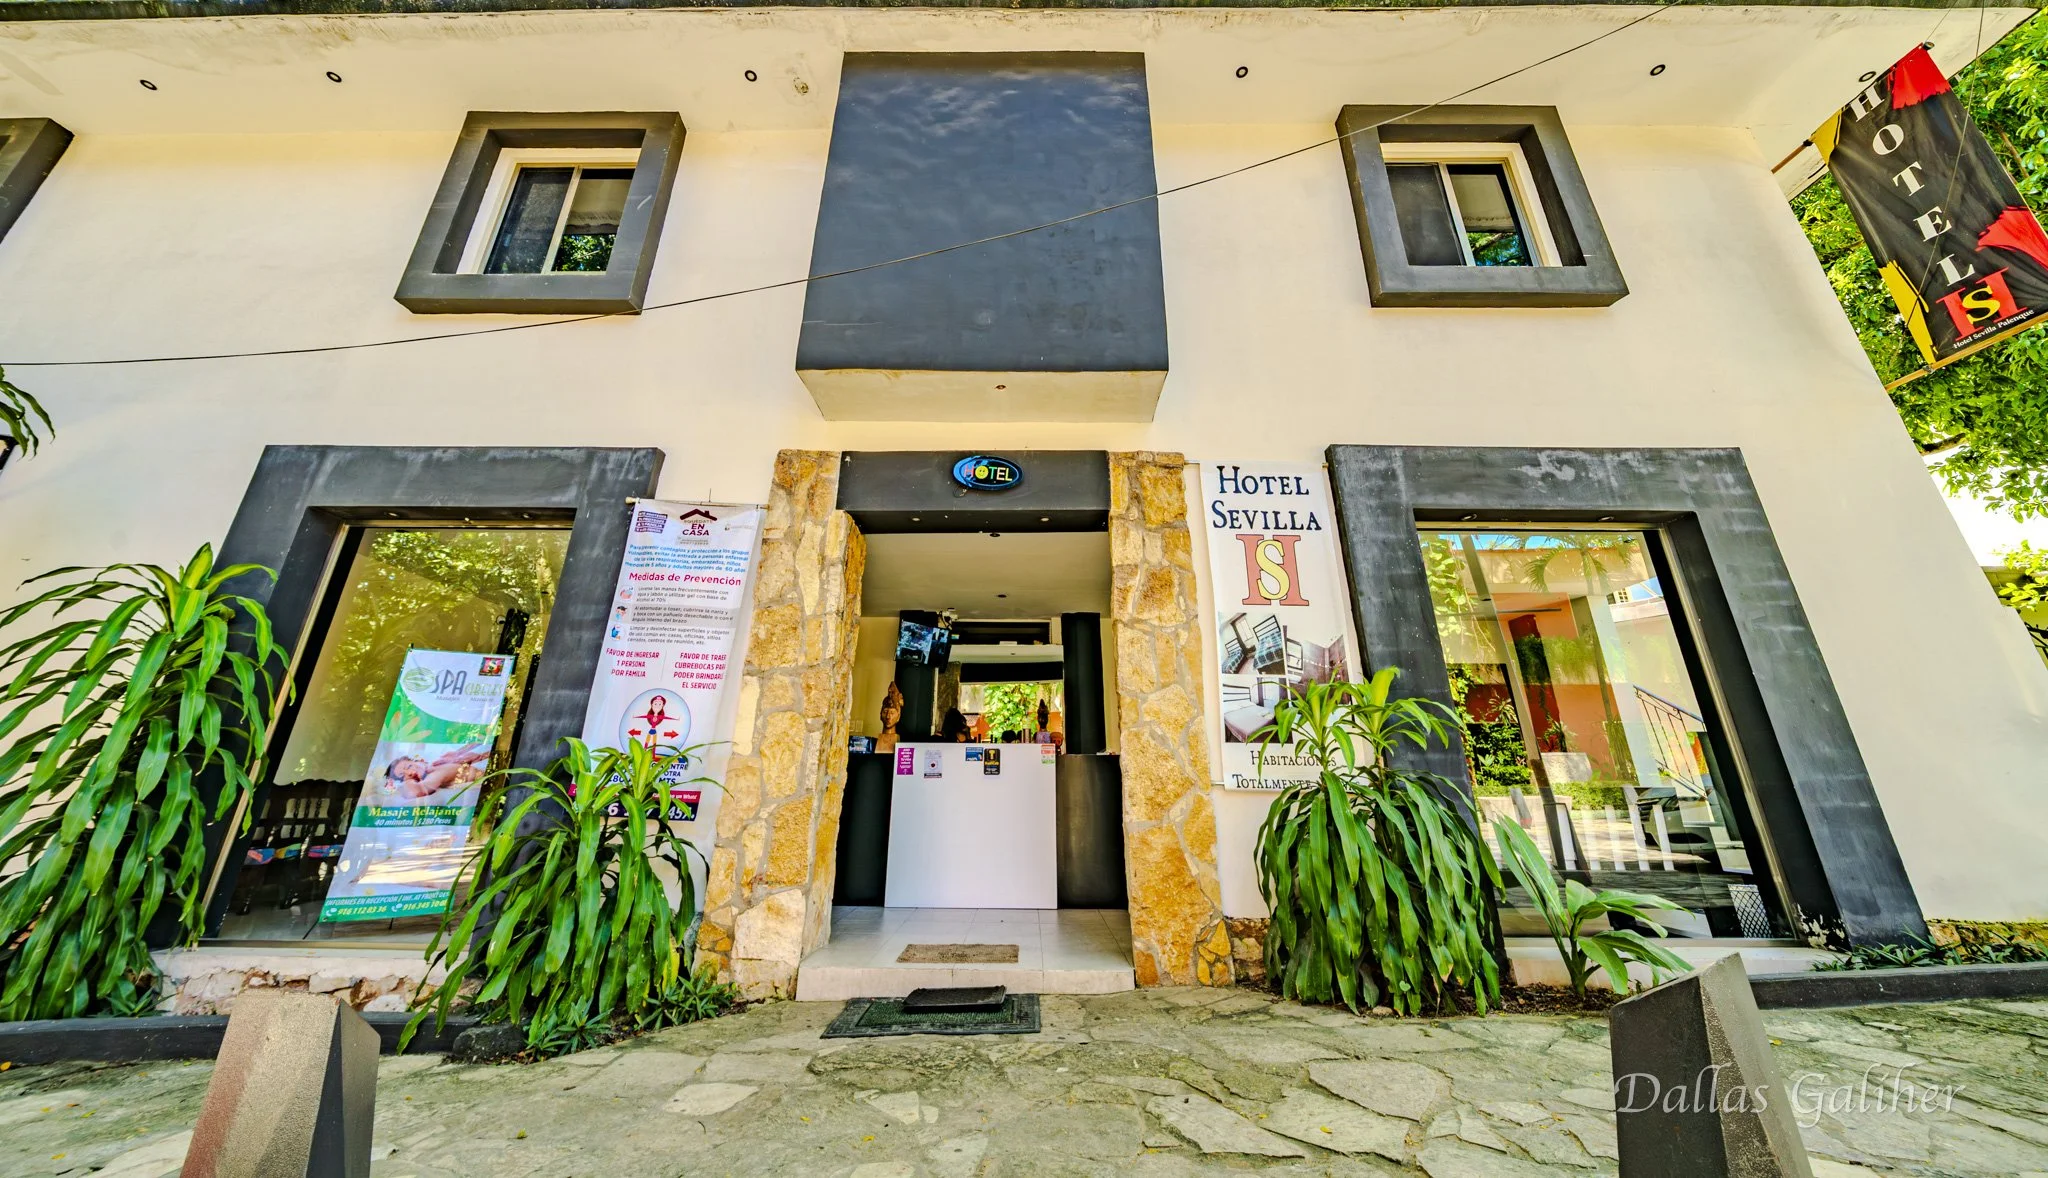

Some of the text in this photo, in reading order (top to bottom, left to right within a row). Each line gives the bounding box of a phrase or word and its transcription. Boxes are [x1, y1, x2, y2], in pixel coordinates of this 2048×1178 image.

[1953, 309, 2035, 349] Hotel Sevilla Palenque
[963, 463, 1012, 482] HOTEL
[1216, 465, 1310, 495] HOTEL
[1211, 500, 1322, 530] SEVILLA
[629, 572, 742, 586] Medidas de Prevención
[606, 648, 624, 657] FAVOR
[675, 662, 715, 670] CUBREBOCAS
[430, 669, 468, 696] SPA
[368, 806, 462, 819] Masaje Relajante
